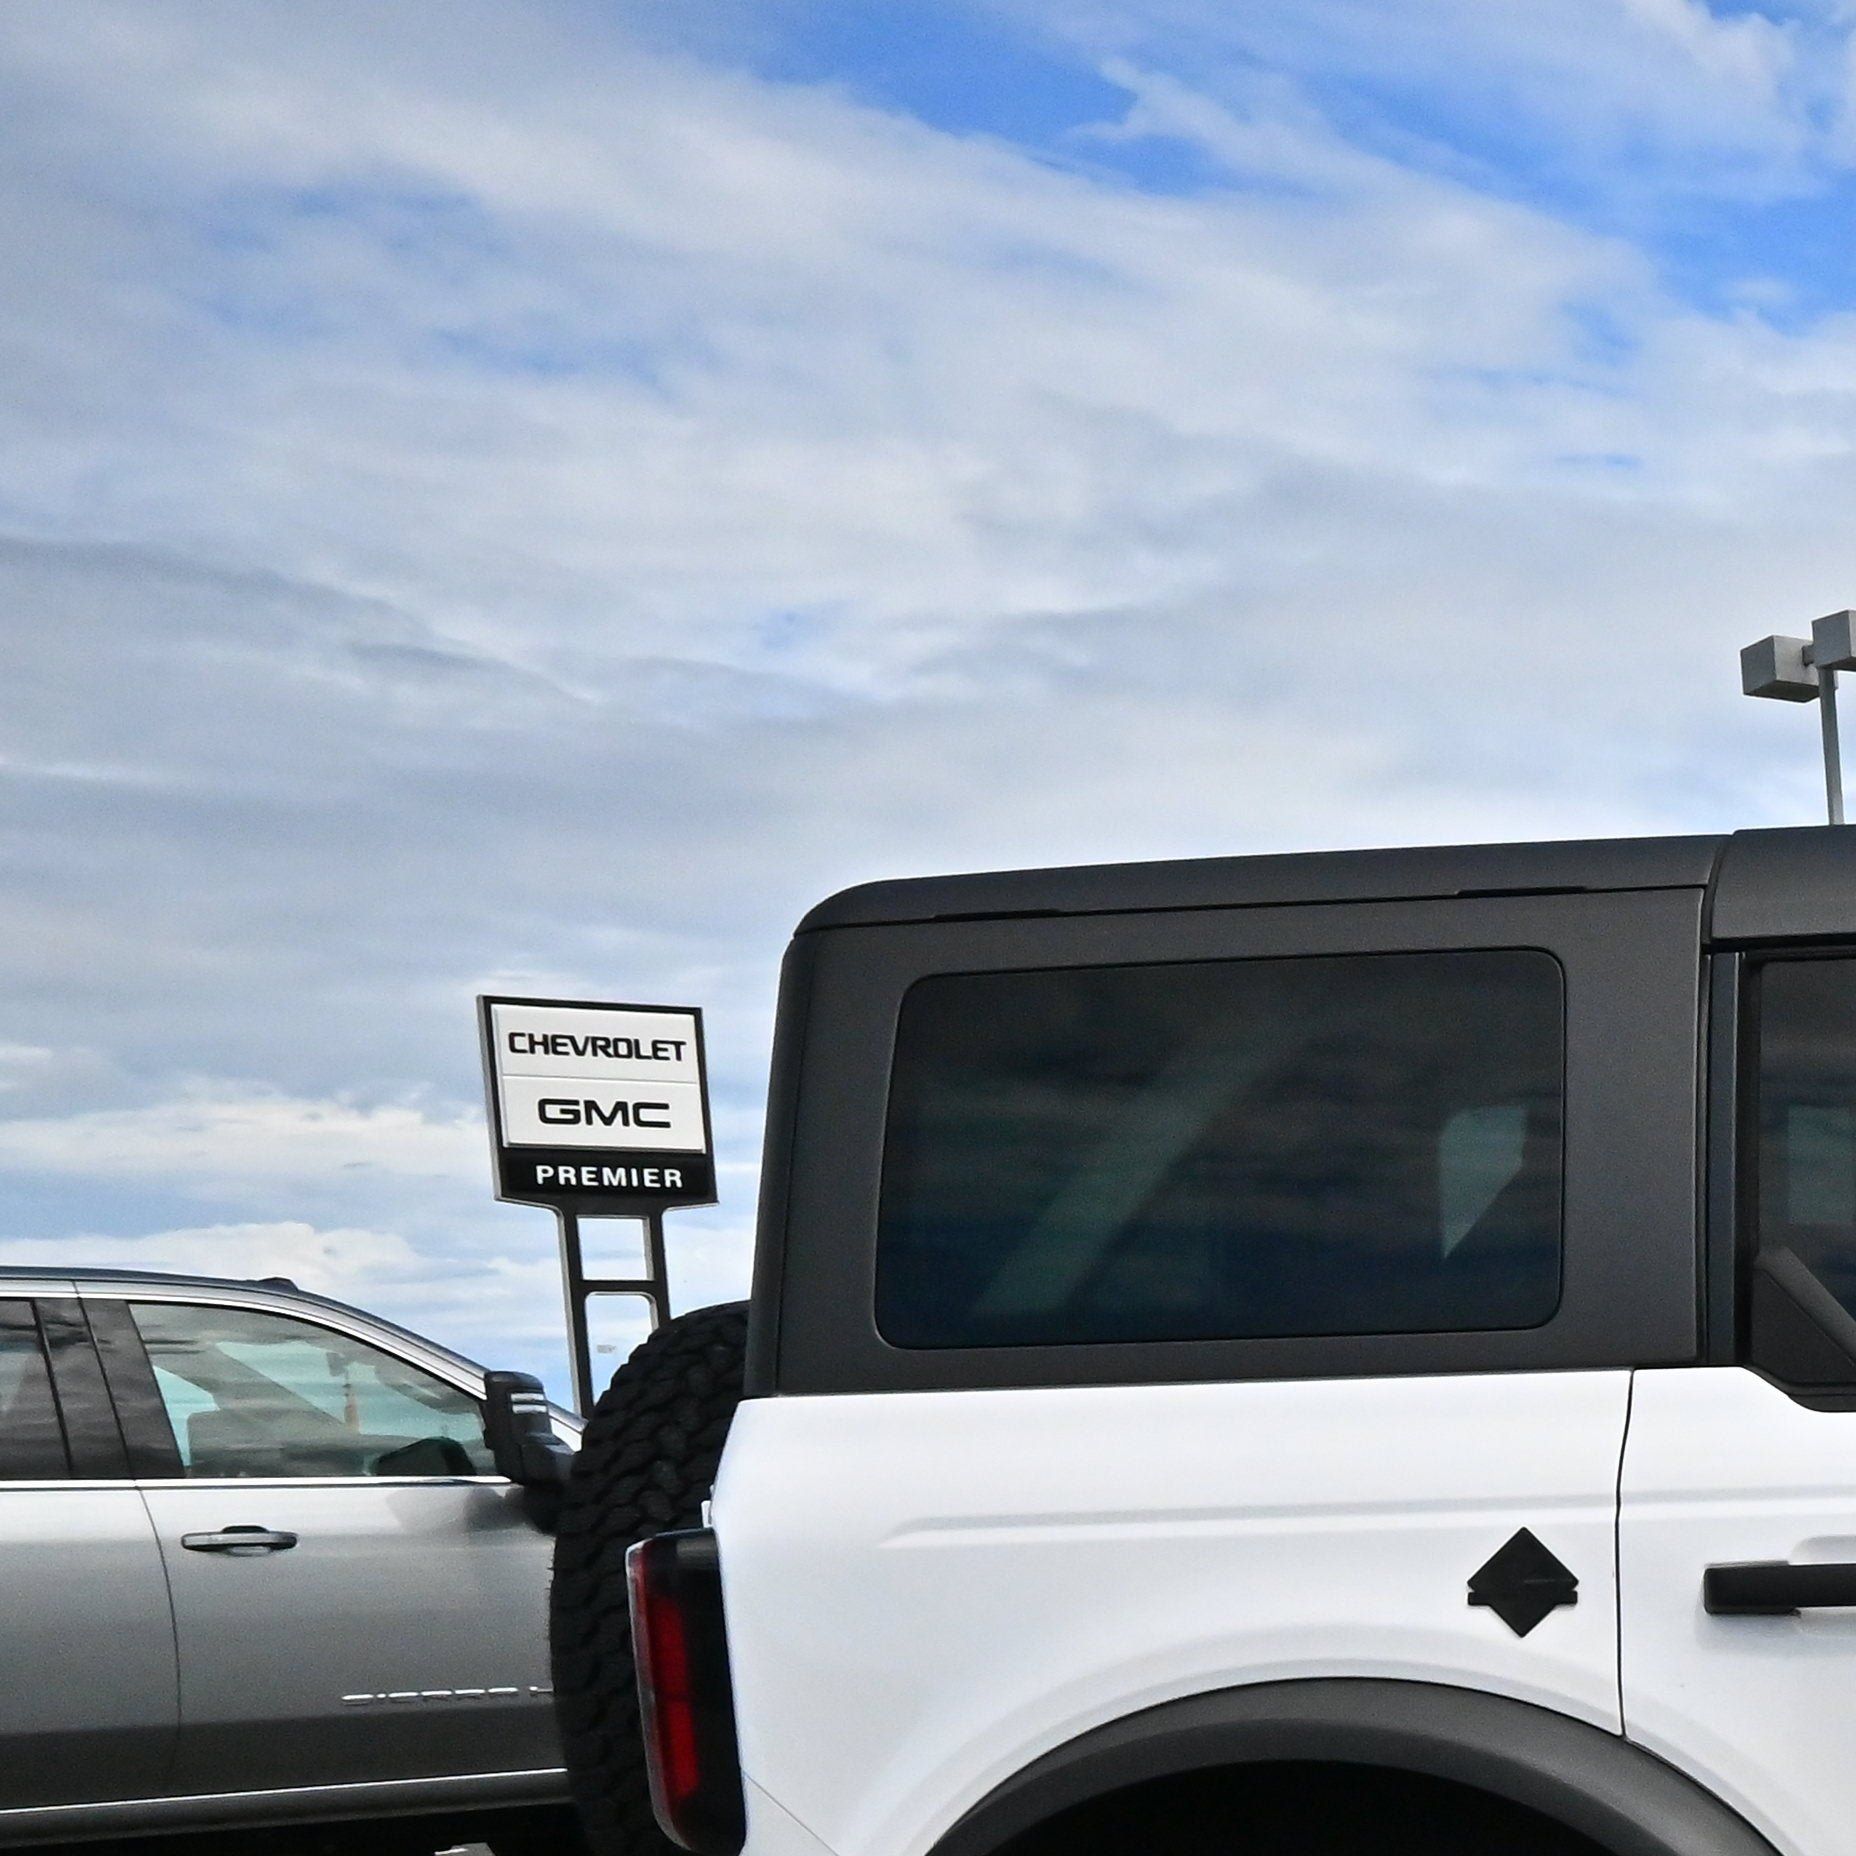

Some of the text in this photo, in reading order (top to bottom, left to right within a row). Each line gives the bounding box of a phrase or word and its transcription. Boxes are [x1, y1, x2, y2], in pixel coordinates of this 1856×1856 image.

[508, 1032, 686, 1062] CHEVROLET
[537, 1097, 671, 1129] GMC
[536, 1165, 683, 1189] PREMIER
